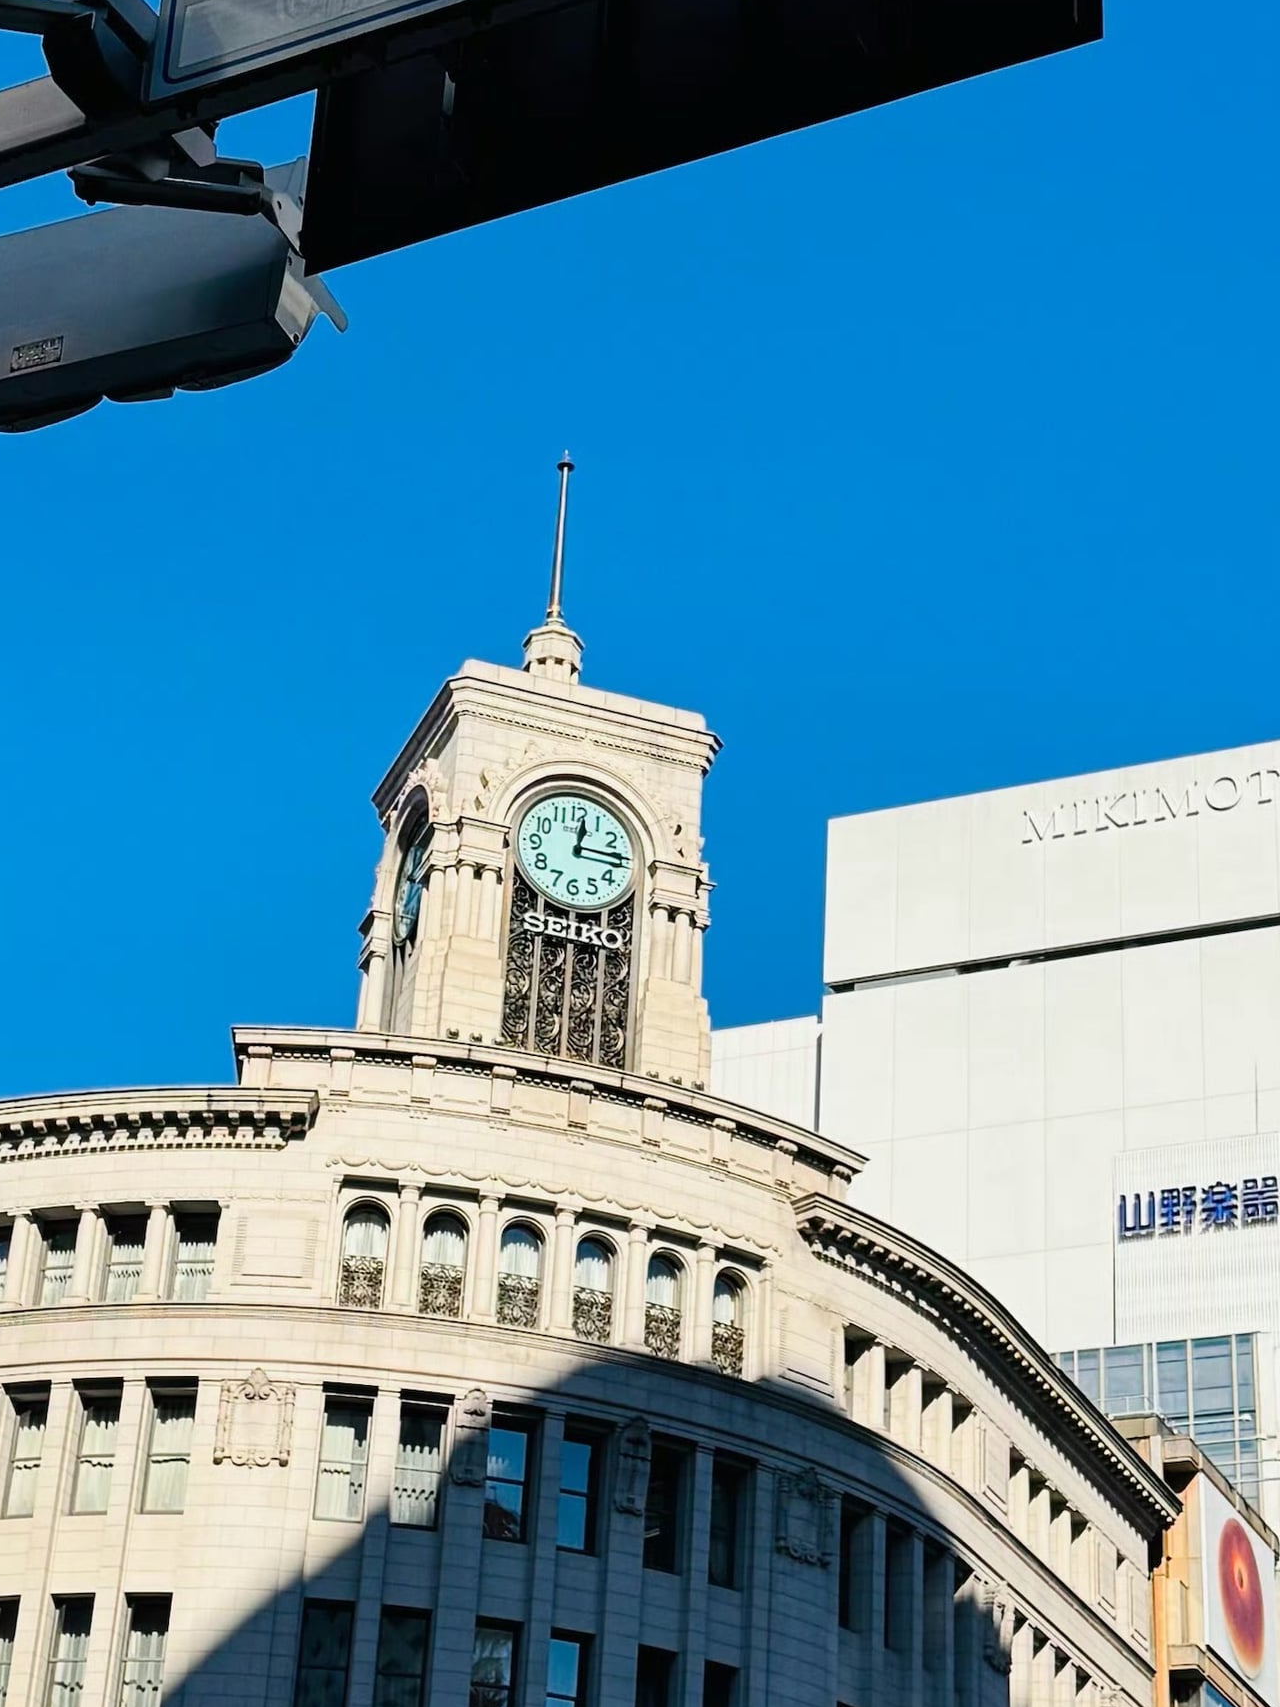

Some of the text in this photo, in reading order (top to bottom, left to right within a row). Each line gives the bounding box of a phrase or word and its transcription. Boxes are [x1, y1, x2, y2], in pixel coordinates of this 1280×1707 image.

[554, 806, 566, 824] 11
[571, 805, 588, 823] 12
[536, 816, 552, 835] 10
[595, 815, 601, 832] 1
[529, 833, 543, 850] 9
[605, 831, 618, 849] 2
[534, 853, 548, 870] 8
[549, 869, 564, 887] 7
[585, 878, 599, 895] 5
[601, 869, 616, 886] 4
[566, 879, 580, 896] 6
[524, 912, 623, 949] SEIKO
[1117, 1175, 1280, 1243] 山野楽器
